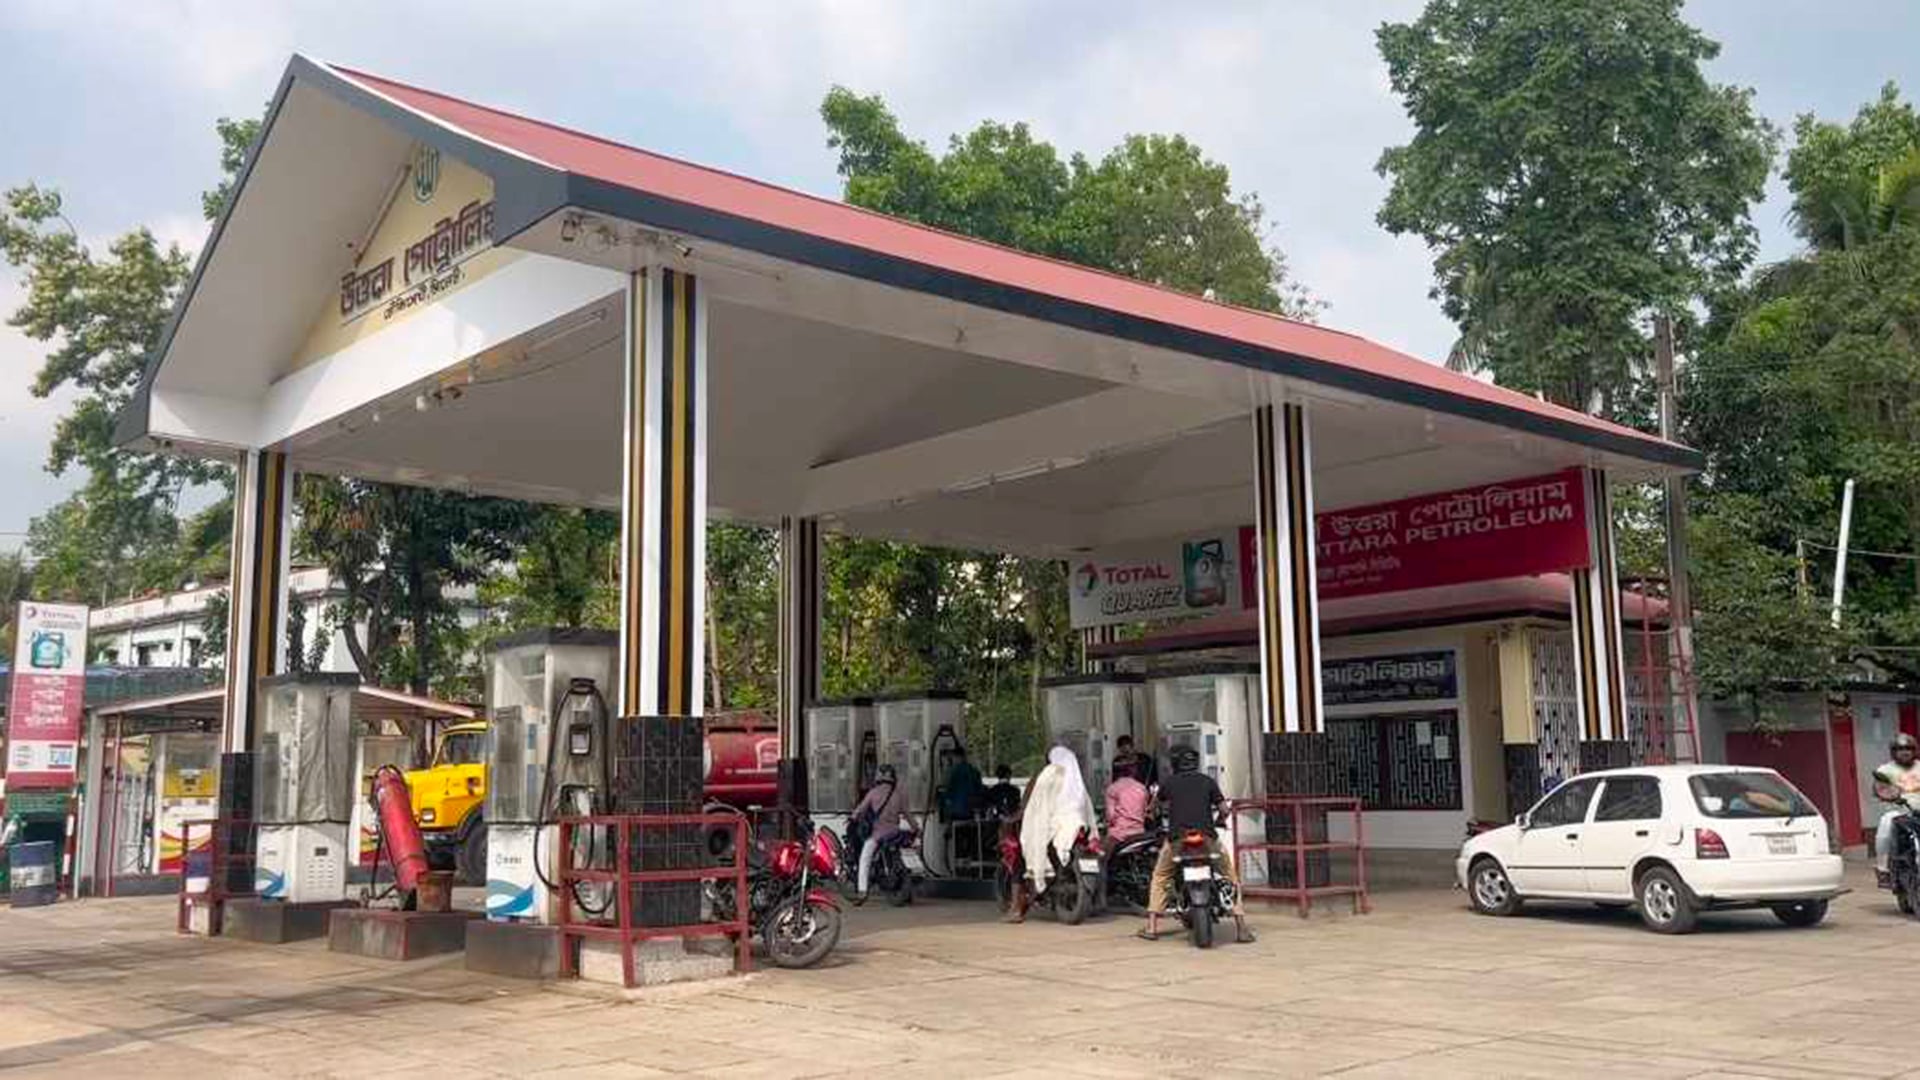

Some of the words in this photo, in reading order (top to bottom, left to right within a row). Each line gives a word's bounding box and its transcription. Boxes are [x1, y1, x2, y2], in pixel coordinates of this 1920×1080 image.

[341, 257, 395, 316] উত্তরা
[1332, 510, 1400, 538] উত্তরা
[1408, 481, 1569, 526] পেট্রোলিয়াম
[1405, 504, 1573, 545] PETROLEUM
[1103, 565, 1170, 585] TOTAL
[1101, 586, 1183, 615] QUARTZ
